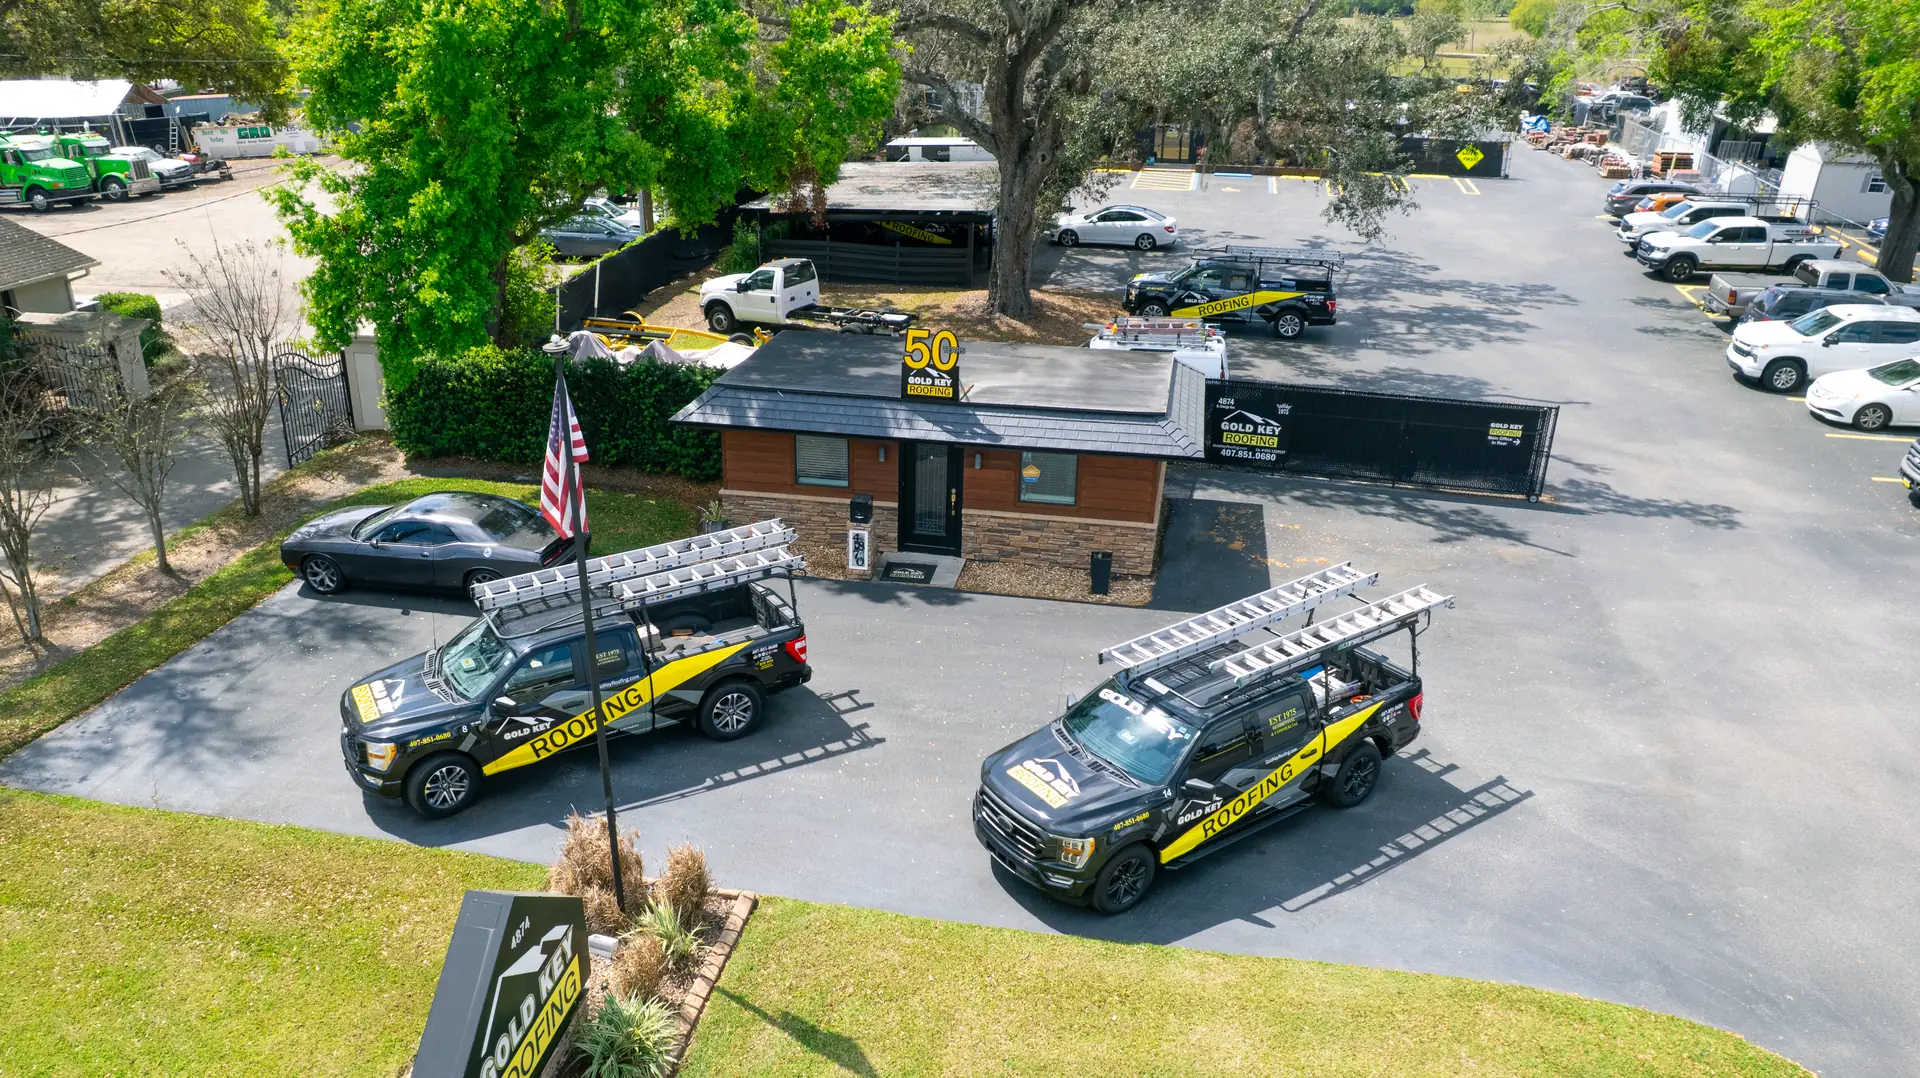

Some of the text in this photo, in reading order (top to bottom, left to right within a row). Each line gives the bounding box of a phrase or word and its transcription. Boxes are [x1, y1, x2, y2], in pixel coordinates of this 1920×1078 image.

[892, 221, 935, 242] ROOFING
[1198, 297, 1250, 316] ROOFING
[903, 328, 959, 371] 50
[908, 376, 952, 387] GOLD KEY
[909, 385, 951, 396] ROOFING
[1218, 397, 1235, 405] 4874
[1221, 421, 1282, 435] GOLD KEY
[1491, 429, 1521, 437] ROOFING
[1225, 433, 1275, 446] ROOFING
[1220, 448, 1277, 461] 407.851.0680
[852, 533, 865, 567] 4870
[595, 648, 620, 660] EST 1975
[354, 685, 379, 720] ROOFING
[1099, 688, 1144, 715] GOLD
[529, 687, 644, 759] ROOFNG
[1268, 707, 1297, 726] EST 1975
[462, 725, 468, 733] 8
[503, 722, 551, 741] GOLD KEY
[409, 731, 451, 747] 407-851-0680
[1014, 768, 1062, 805] ROOFING
[1162, 788, 1173, 799] 14
[1202, 763, 1293, 839] ROOFING
[1113, 811, 1150, 831] 407-851-0680
[1177, 800, 1223, 825] GOLD KEY
[511, 915, 531, 950] 4874
[479, 924, 574, 1078] GOLD KEY
